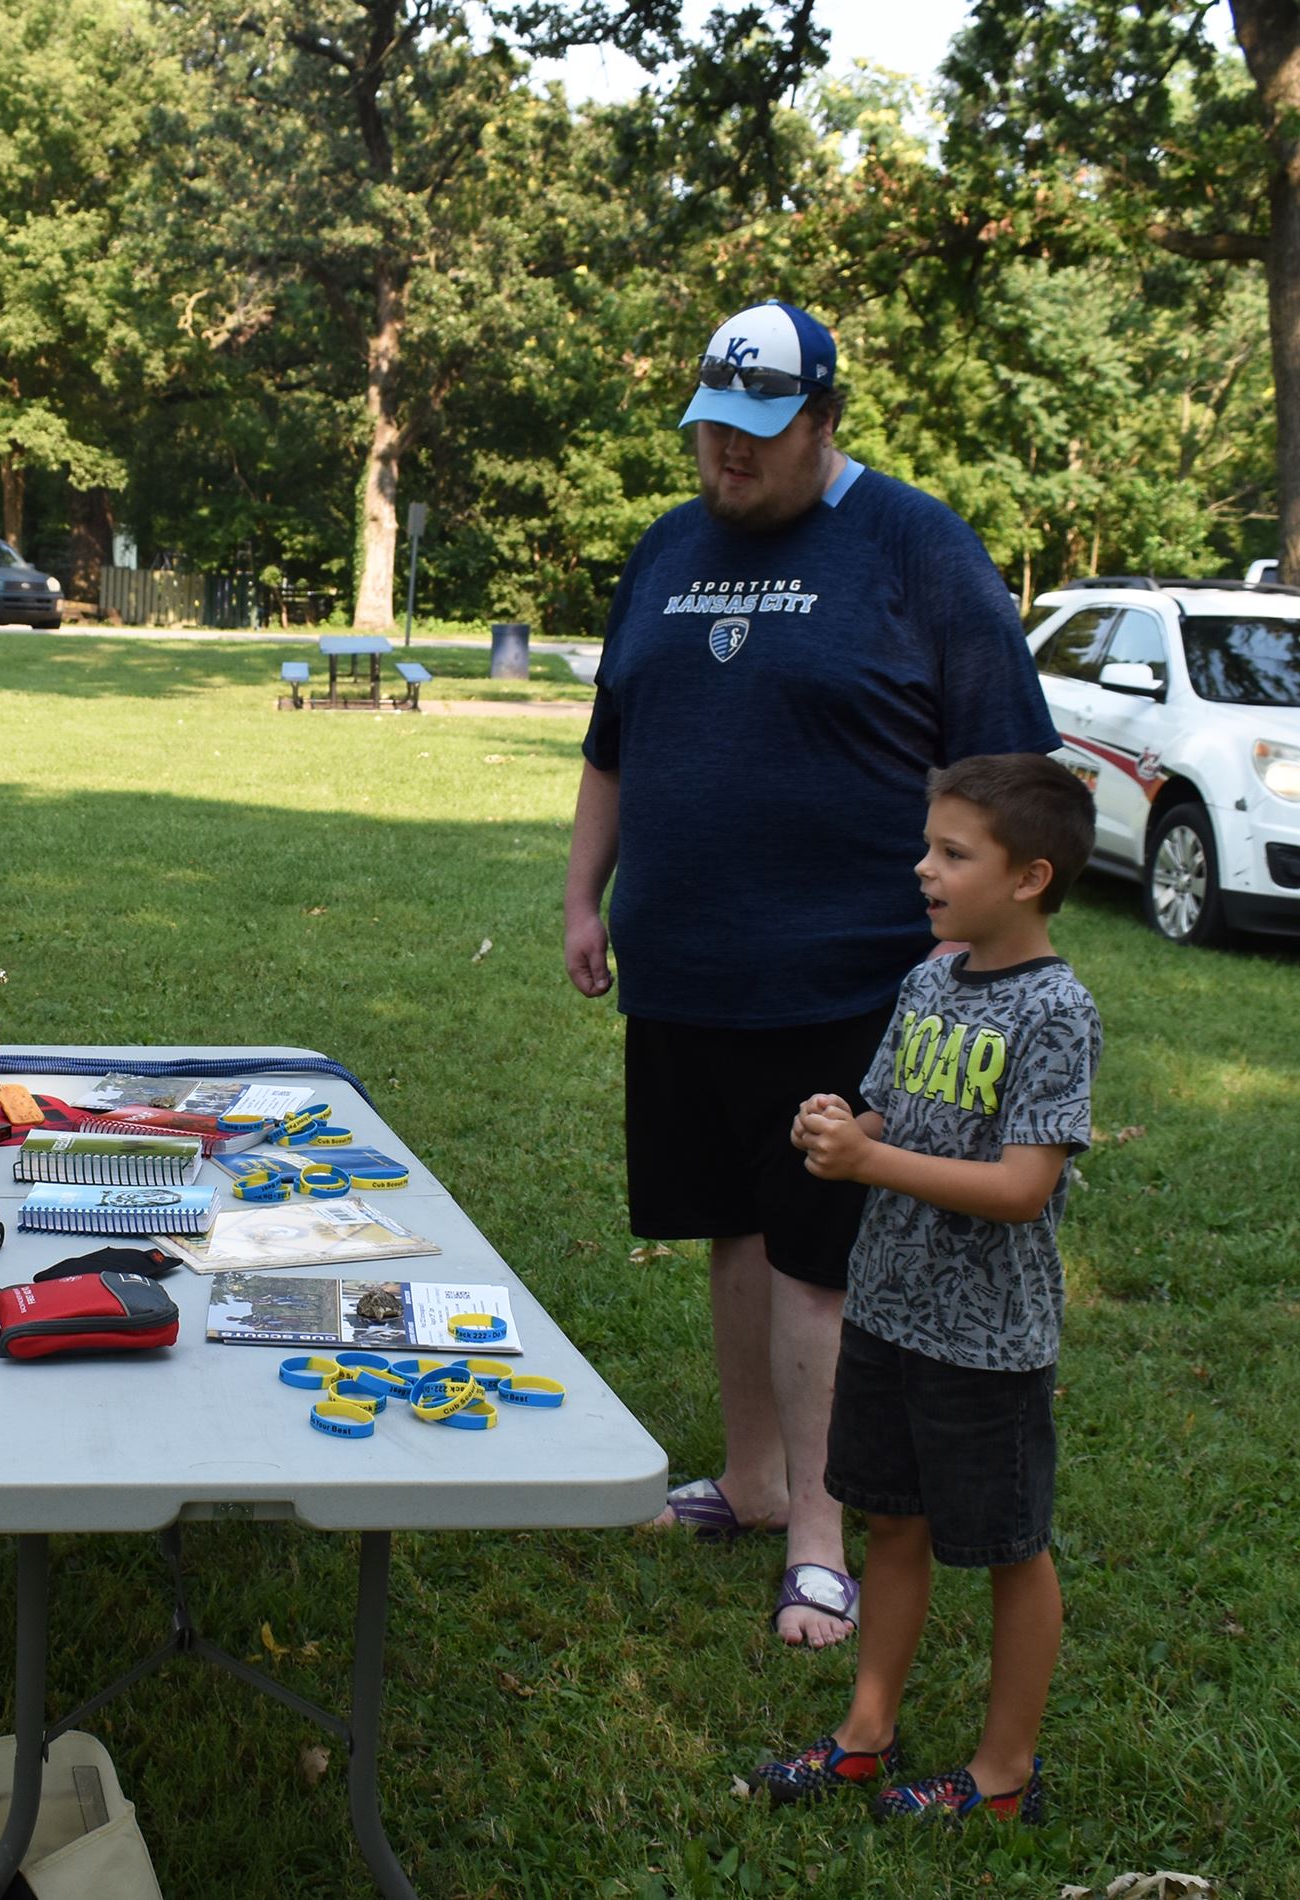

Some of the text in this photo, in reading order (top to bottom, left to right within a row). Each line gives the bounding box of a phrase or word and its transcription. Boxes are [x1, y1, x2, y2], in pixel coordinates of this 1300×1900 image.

[690, 579, 801, 593] SPORTING
[663, 592, 818, 614] KANSAS CITY
[220, 1331, 337, 1342] CUB SCOUTS
[443, 1403, 460, 1415] Cub
[331, 1425, 351, 1435] Best
